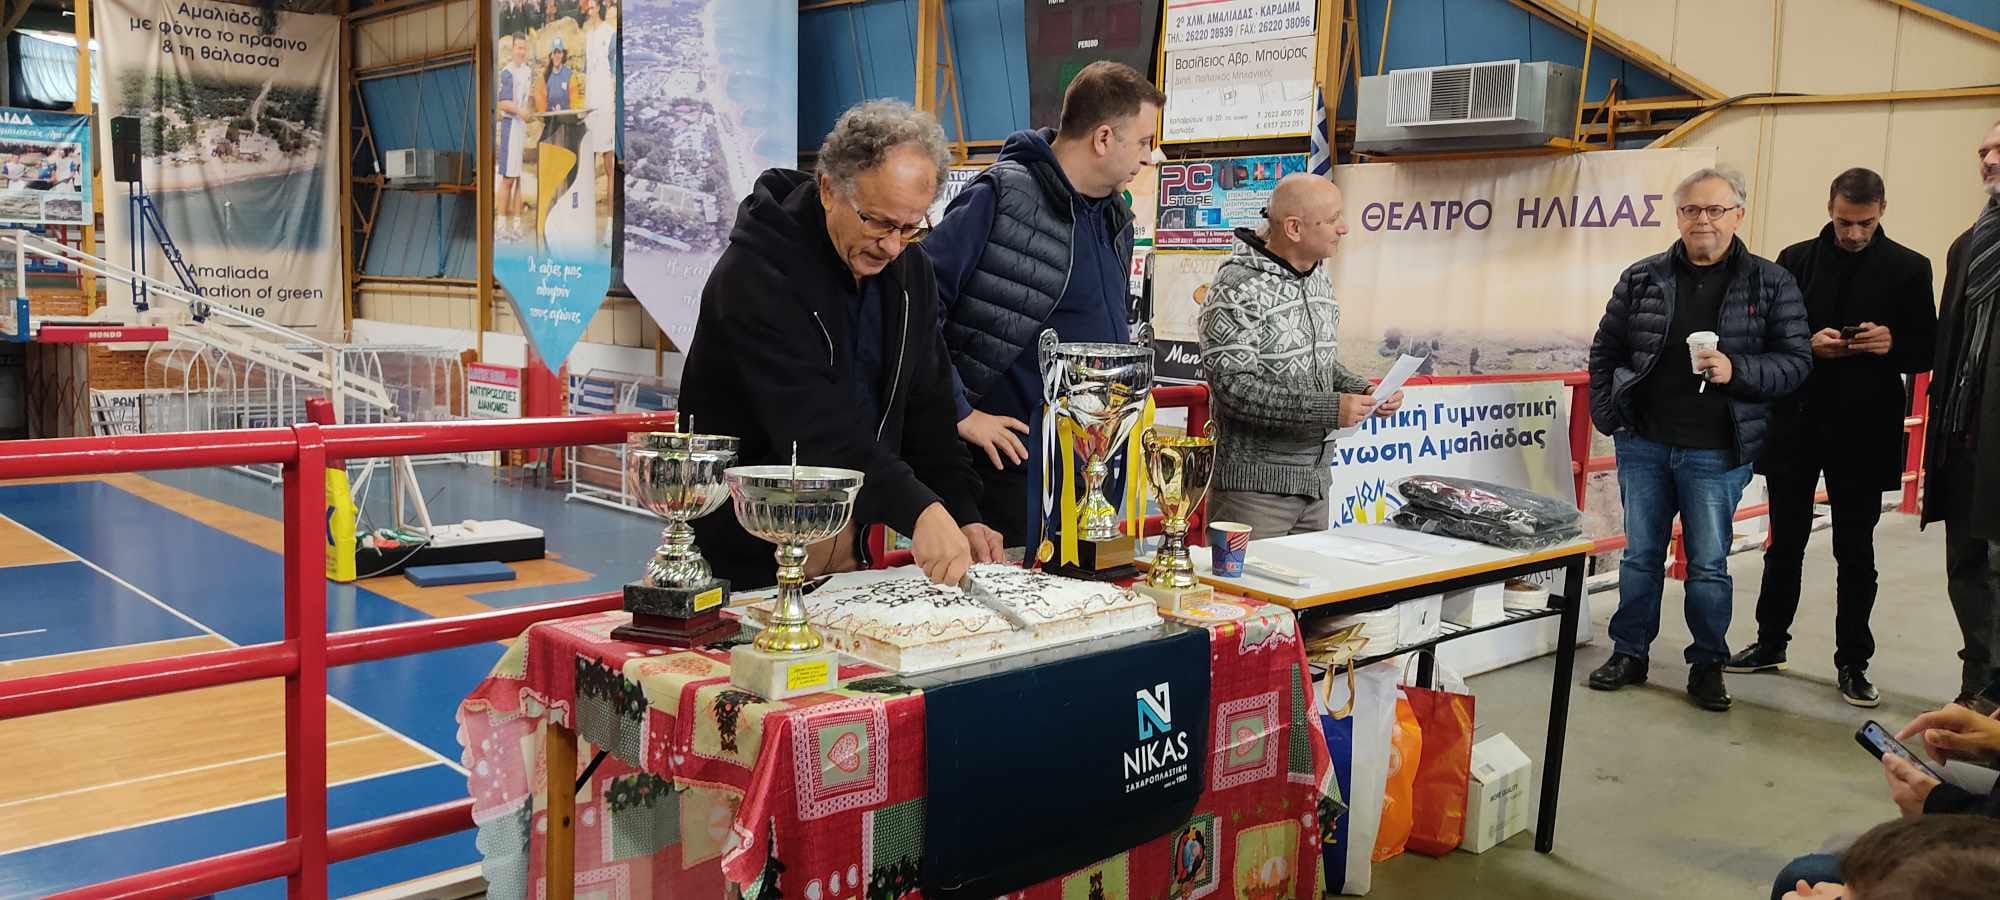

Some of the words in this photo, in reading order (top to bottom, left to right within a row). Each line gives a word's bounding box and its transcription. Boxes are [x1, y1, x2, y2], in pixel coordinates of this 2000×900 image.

[1207, 7, 1253, 24] ΑΜΑΛΙΑΔΑΣ
[1260, 1, 1301, 16] ΚΑΡΔΑΜΑ
[129, 16, 152, 31] με
[158, 19, 212, 40] φόντο
[217, 29, 234, 42] το
[1185, 29, 1209, 42] 26220
[1210, 26, 1233, 39] 28939
[1258, 19, 1283, 33] 26220
[1285, 15, 1311, 28] 38096
[162, 39, 174, 53] &
[180, 44, 194, 60] τη
[200, 46, 280, 68] θάλασσα
[1255, 46, 1308, 62] Μπούρας
[1160, 163, 1213, 207] PC
[1168, 195, 1212, 206] STORE
[1361, 199, 1493, 232] ΘΕΑΤΡΟ
[1516, 194, 1664, 229] ΗΛΙΔΑΣ
[187, 263, 269, 280] Amaliada
[257, 286, 272, 298] of
[277, 289, 323, 301] green
[1434, 396, 1557, 427] Γυμναστική
[1419, 427, 1547, 461] Αμαλιάδας
[1124, 731, 1189, 780] NIKAS
[1125, 764, 1187, 793] ΖΑΧΑΡΟΠΛΑΣΤΙΚΗ
